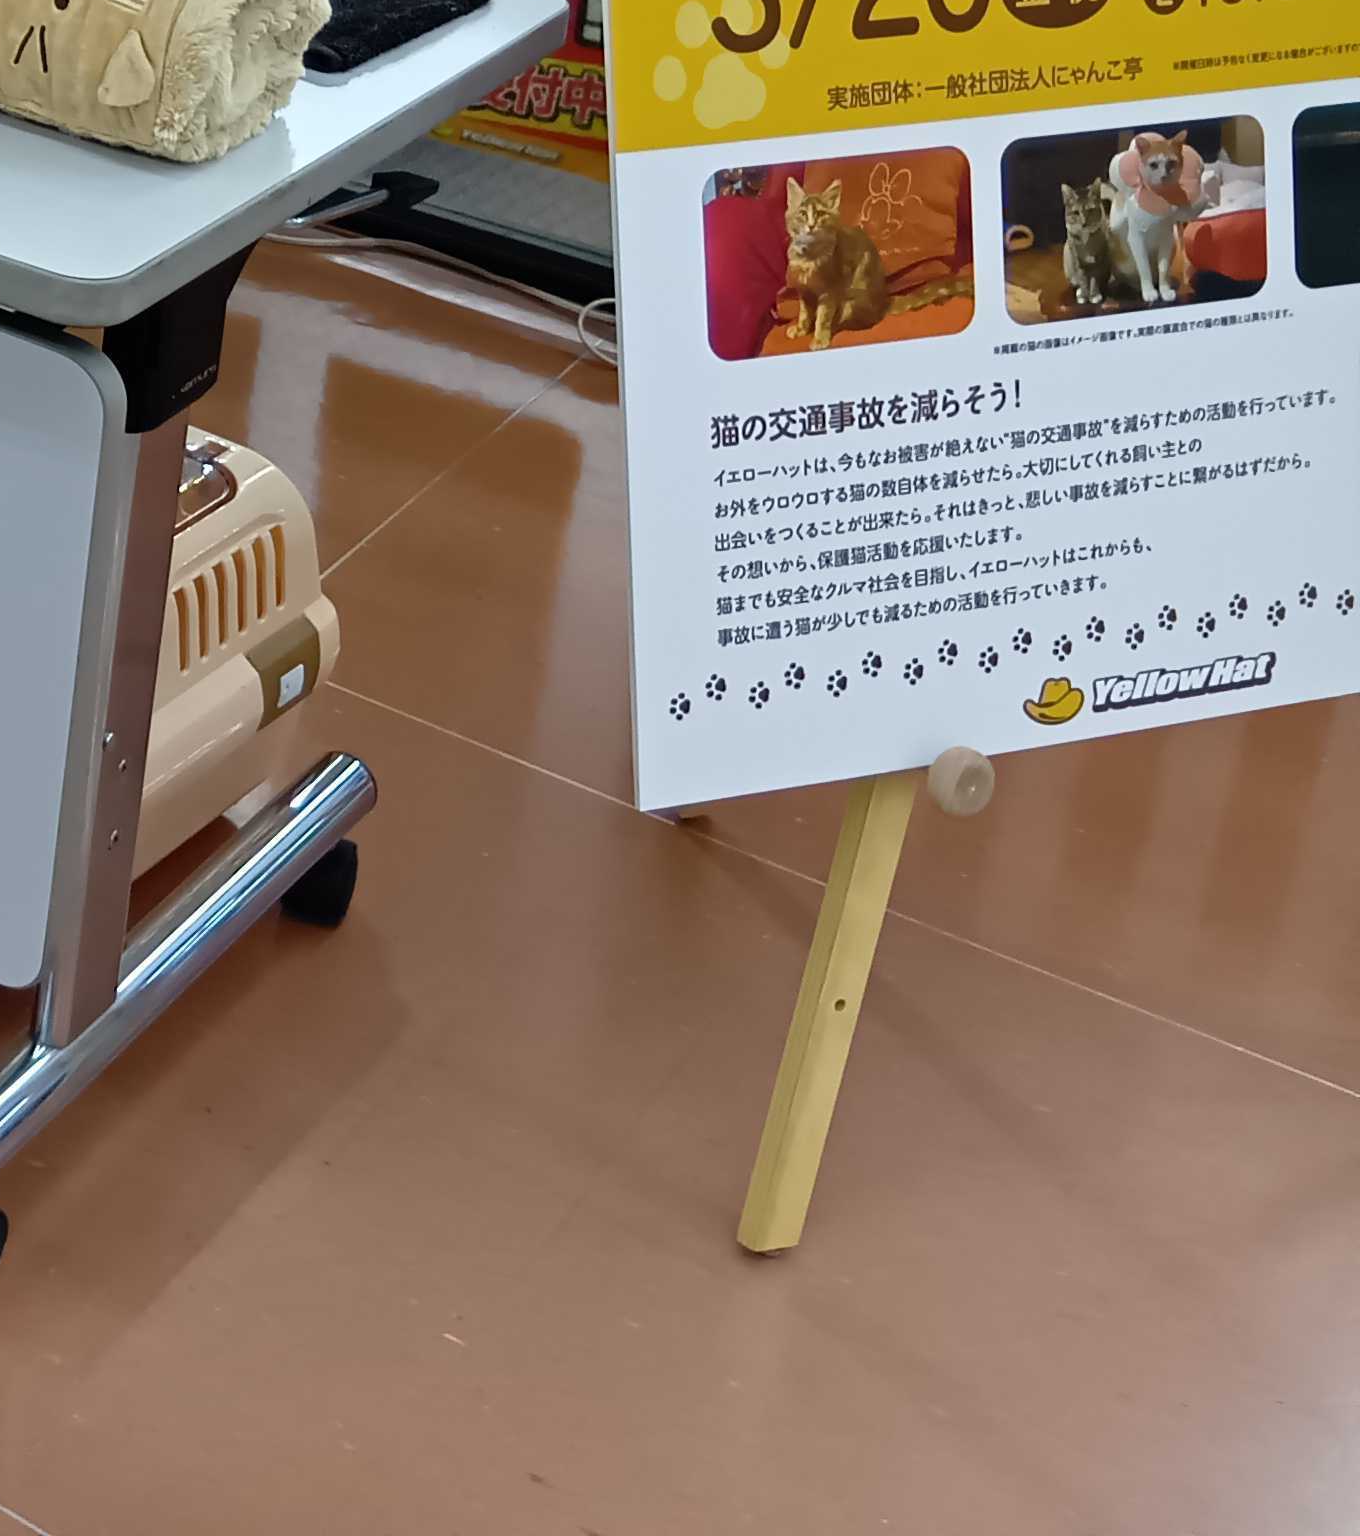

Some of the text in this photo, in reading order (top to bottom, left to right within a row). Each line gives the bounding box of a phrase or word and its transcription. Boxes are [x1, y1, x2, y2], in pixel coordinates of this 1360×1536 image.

[826, 56, 1145, 112] 実施団体：一般社団法人にゃんこ亭
[711, 379, 1023, 449] 猫の交通事故を減らそう！
[714, 437, 1202, 519] お外をウロウロする猫の数自体を減らせたら。大切にしてくれる飼い主との
[716, 528, 1024, 582] その想いから、保護猫活動を応援いたします。
[716, 540, 1154, 615] 猫までも安全なクルマ社会を目指し、イエローハットはこれからも、
[716, 577, 1109, 646] 事故に遭う猫が少しでも減るための活動を行っていきます。
[1091, 651, 1277, 714] YellowHat
